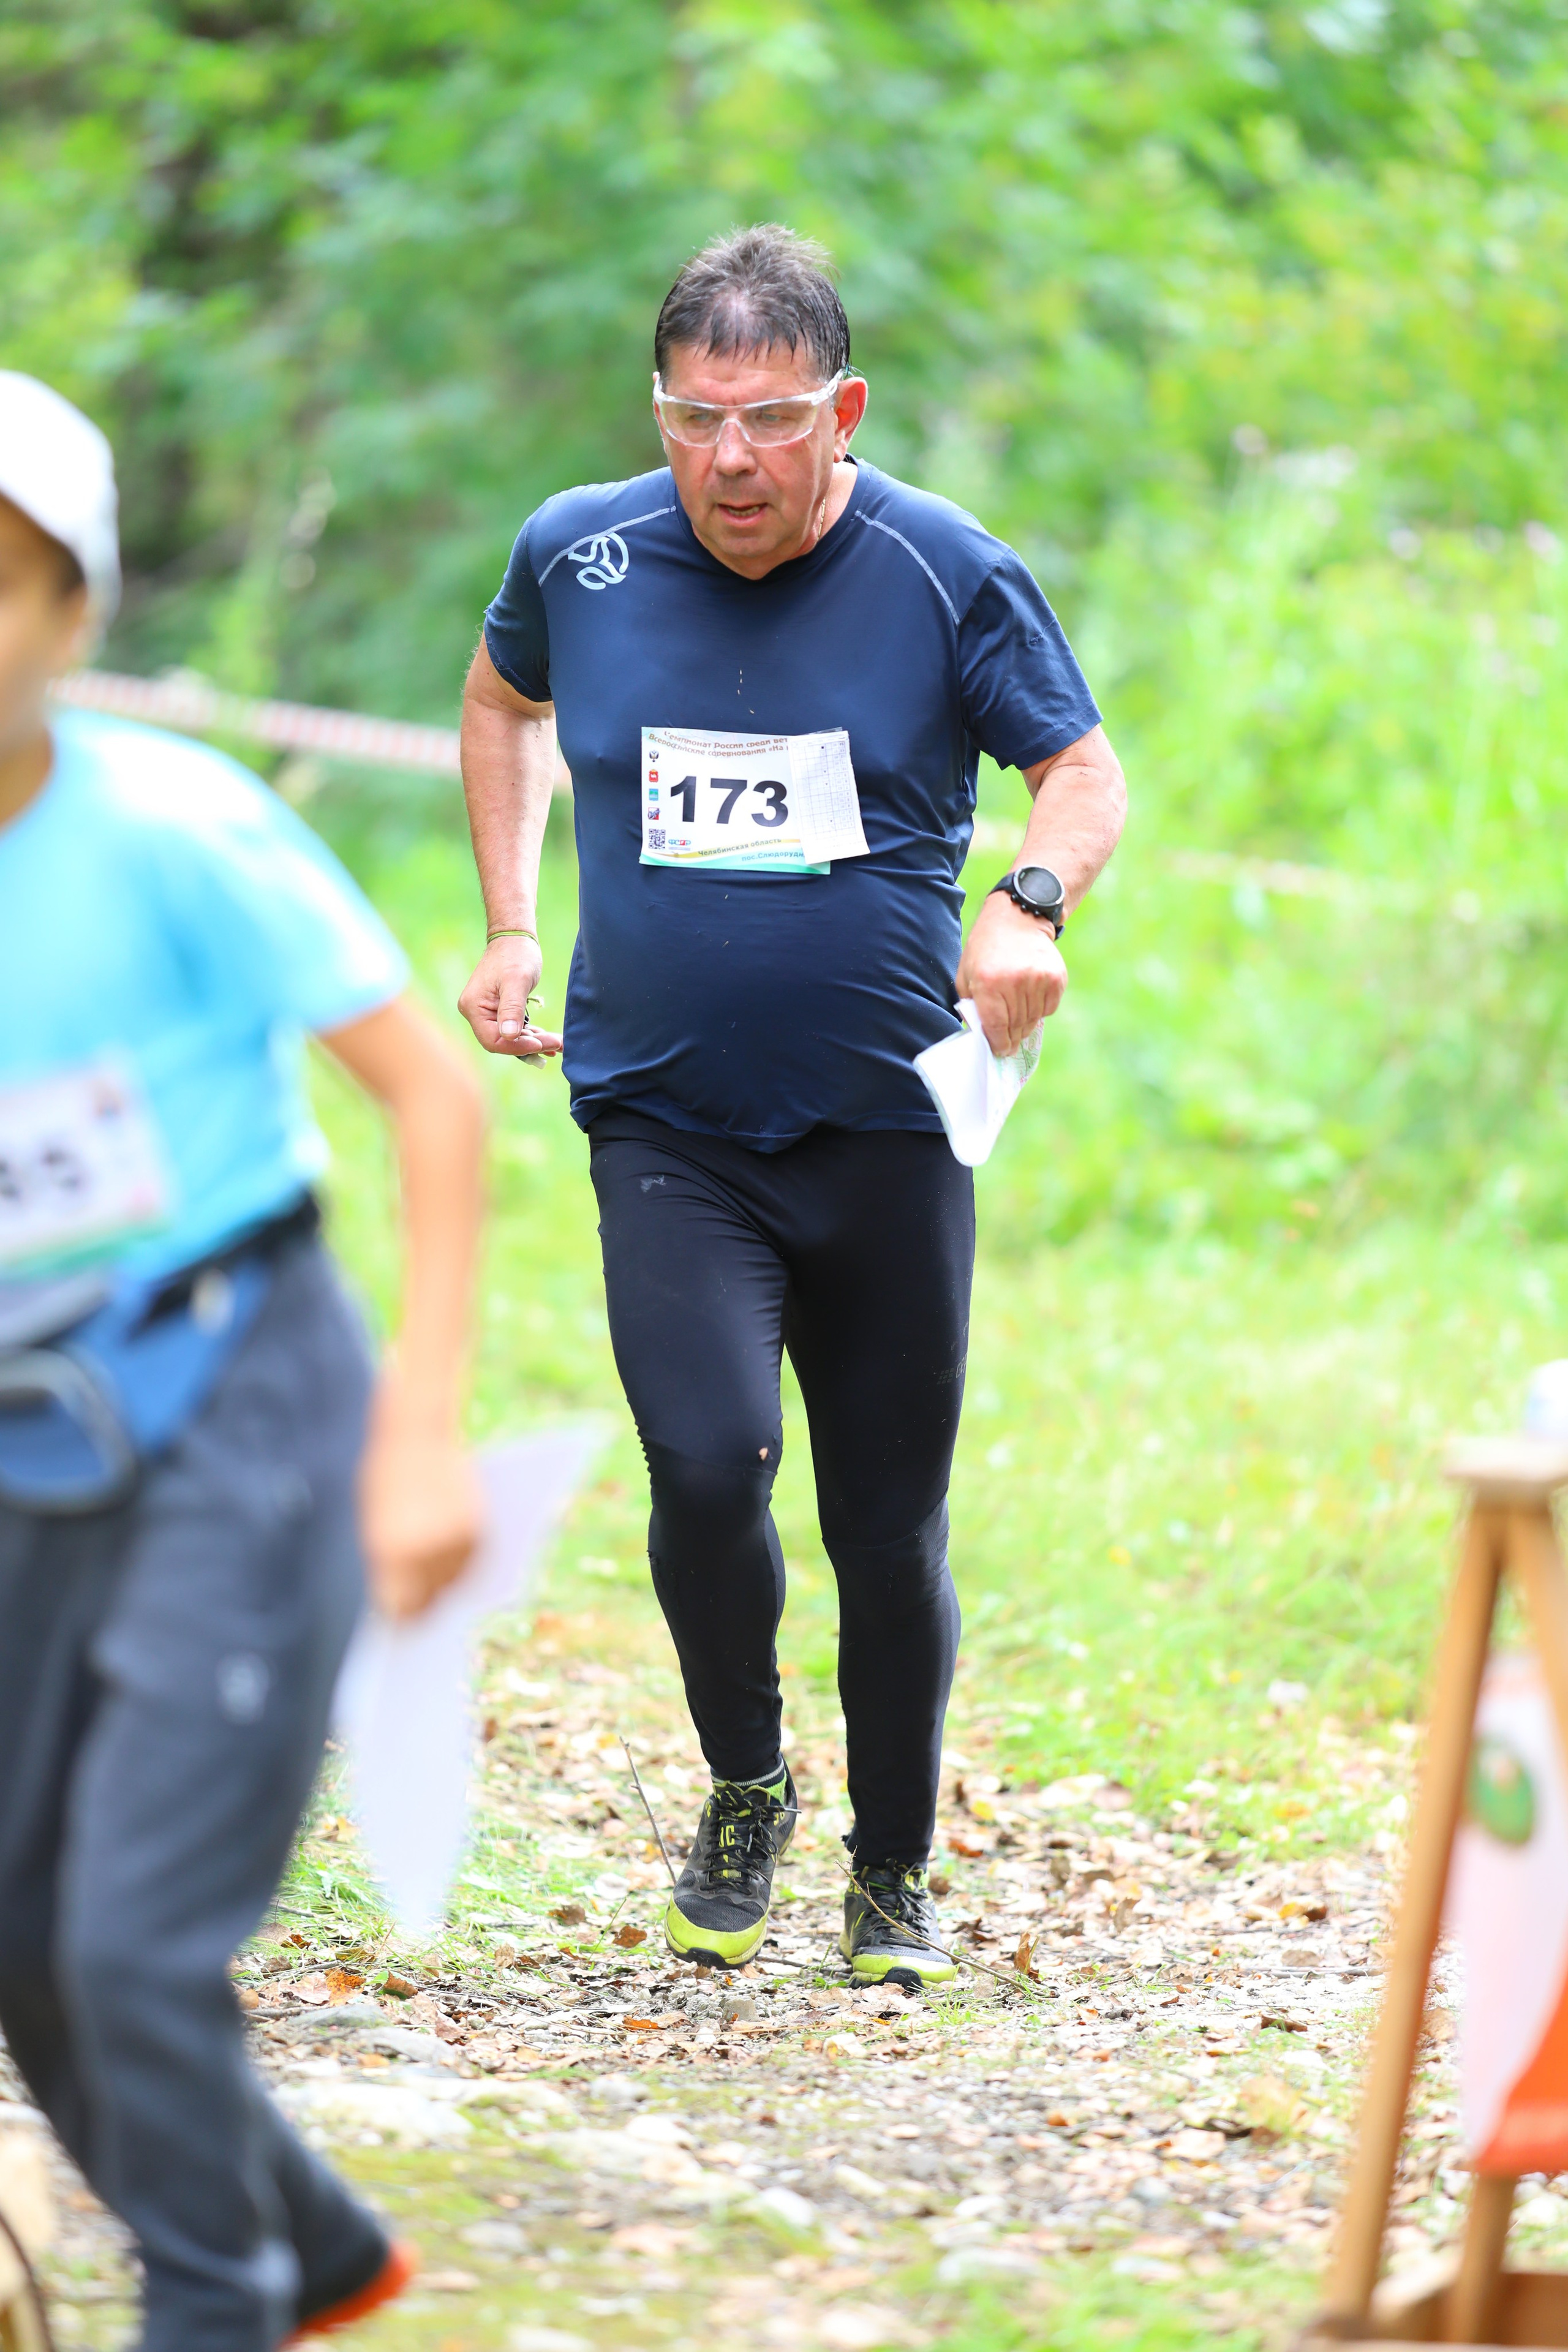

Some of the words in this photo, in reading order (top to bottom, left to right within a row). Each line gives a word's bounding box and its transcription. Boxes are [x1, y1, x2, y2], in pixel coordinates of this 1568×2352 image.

[746, 739, 771, 748] среди
[707, 747, 766, 758] соревнования
[670, 775, 788, 827] 173
[698, 842, 749, 856] Челябинская
[750, 838, 782, 848] область
[742, 851, 805, 862] пос.Слюдорудн
